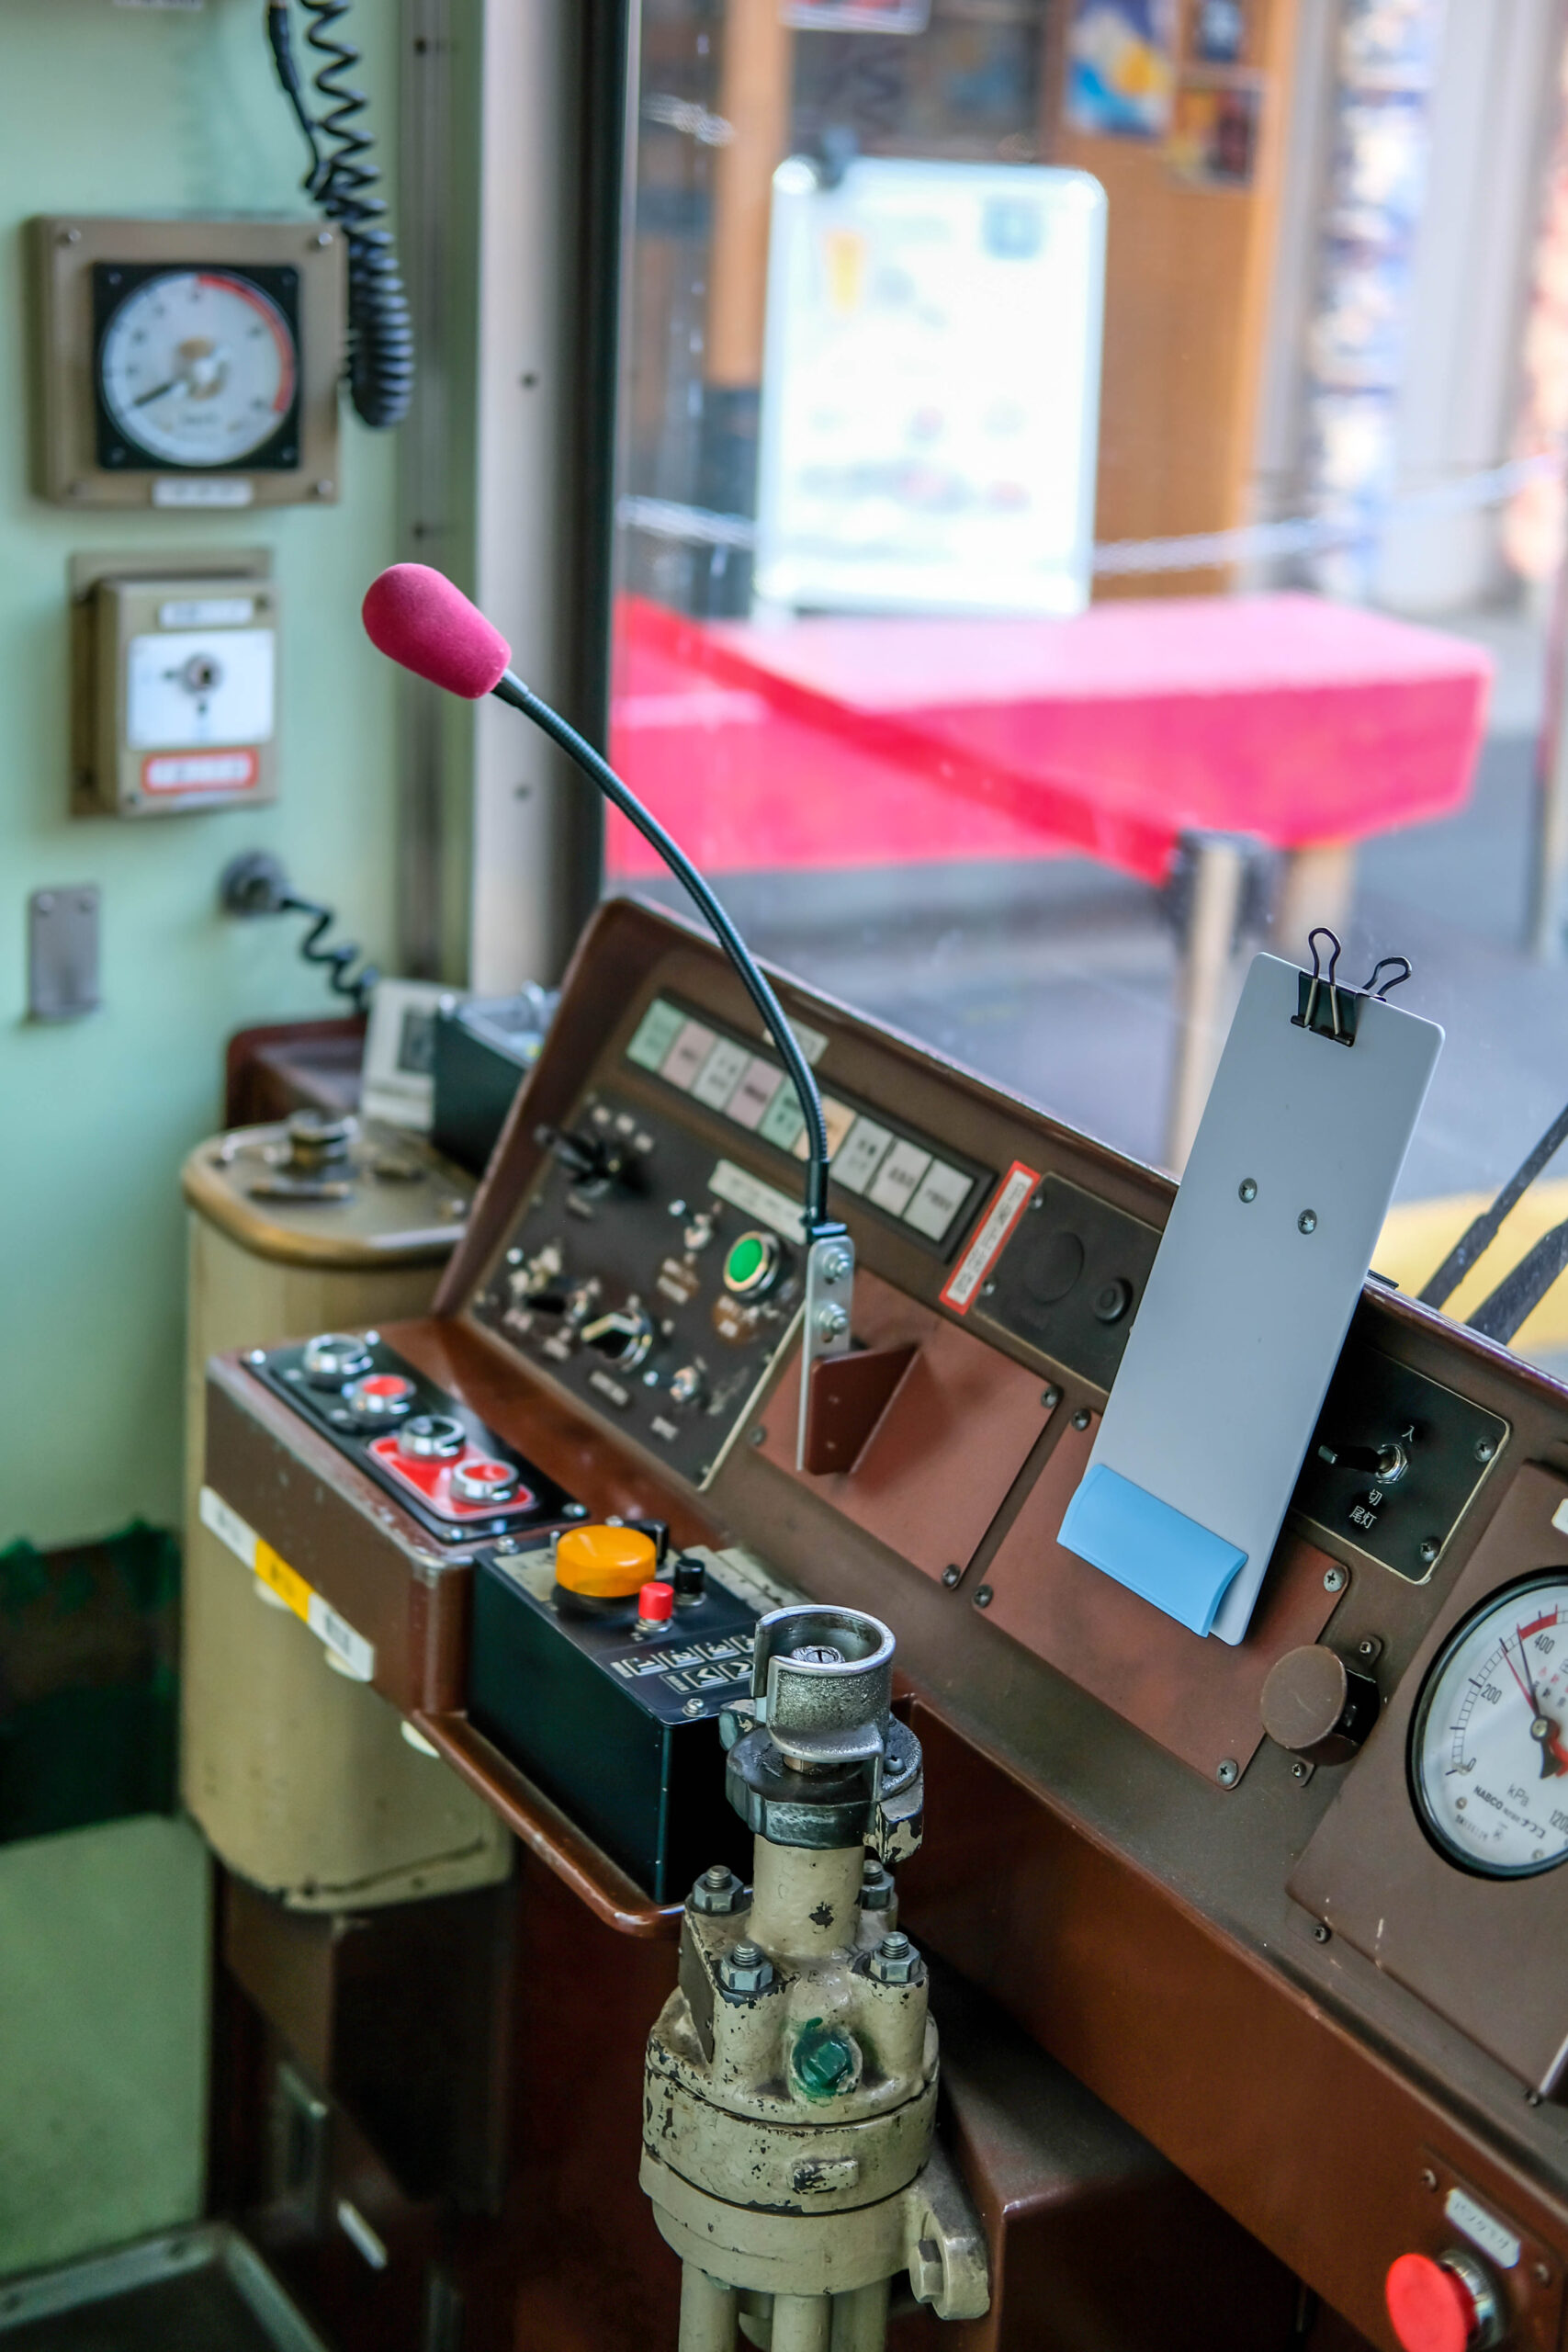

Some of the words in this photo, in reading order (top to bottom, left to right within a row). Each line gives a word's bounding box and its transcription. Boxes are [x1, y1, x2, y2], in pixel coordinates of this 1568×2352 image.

[1402, 1425, 1416, 1442] 入
[1368, 1488, 1382, 1507] 切
[1348, 1505, 1378, 1530] 尾灯
[1533, 1634, 1556, 1655] 400
[1481, 1683, 1503, 1705] 200
[1473, 1784, 1505, 1811] NABCO
[1507, 1782, 1530, 1808] kPa
